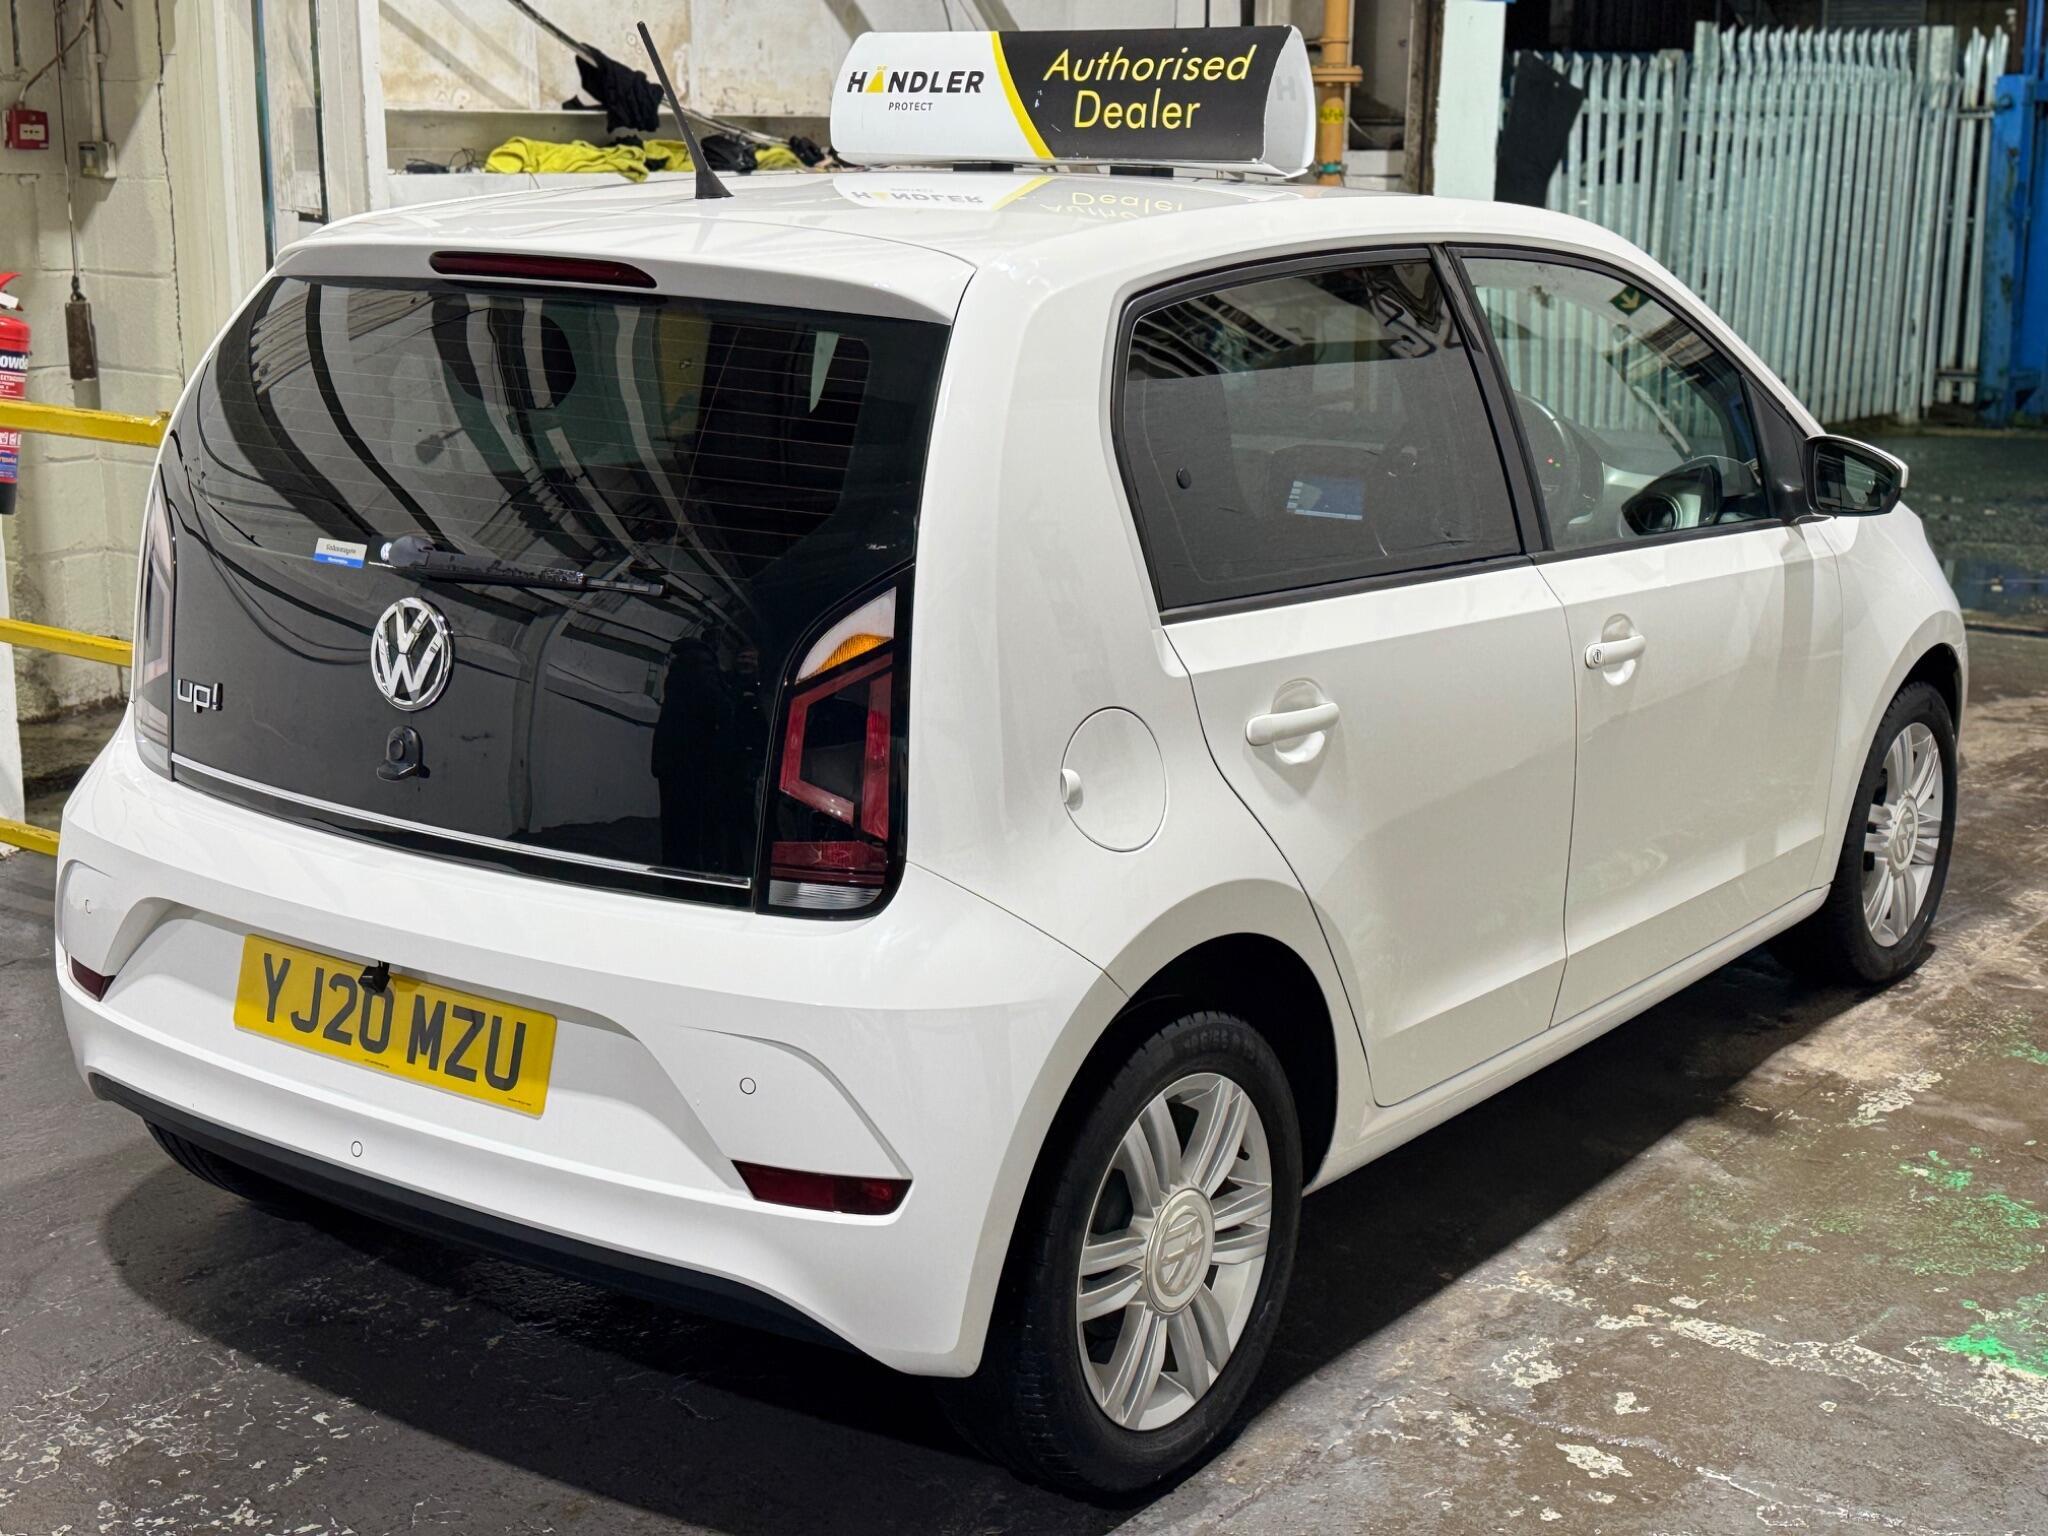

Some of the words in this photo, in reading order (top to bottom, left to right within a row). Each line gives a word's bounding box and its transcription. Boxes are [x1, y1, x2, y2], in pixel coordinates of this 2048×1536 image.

[1043, 44, 1258, 81] Authorised
[888, 102, 933, 111] PROTECT
[1074, 88, 1201, 129] Dealer
[177, 679, 223, 713] up!
[263, 953, 394, 1053] YJ20
[407, 994, 527, 1092] MZU
